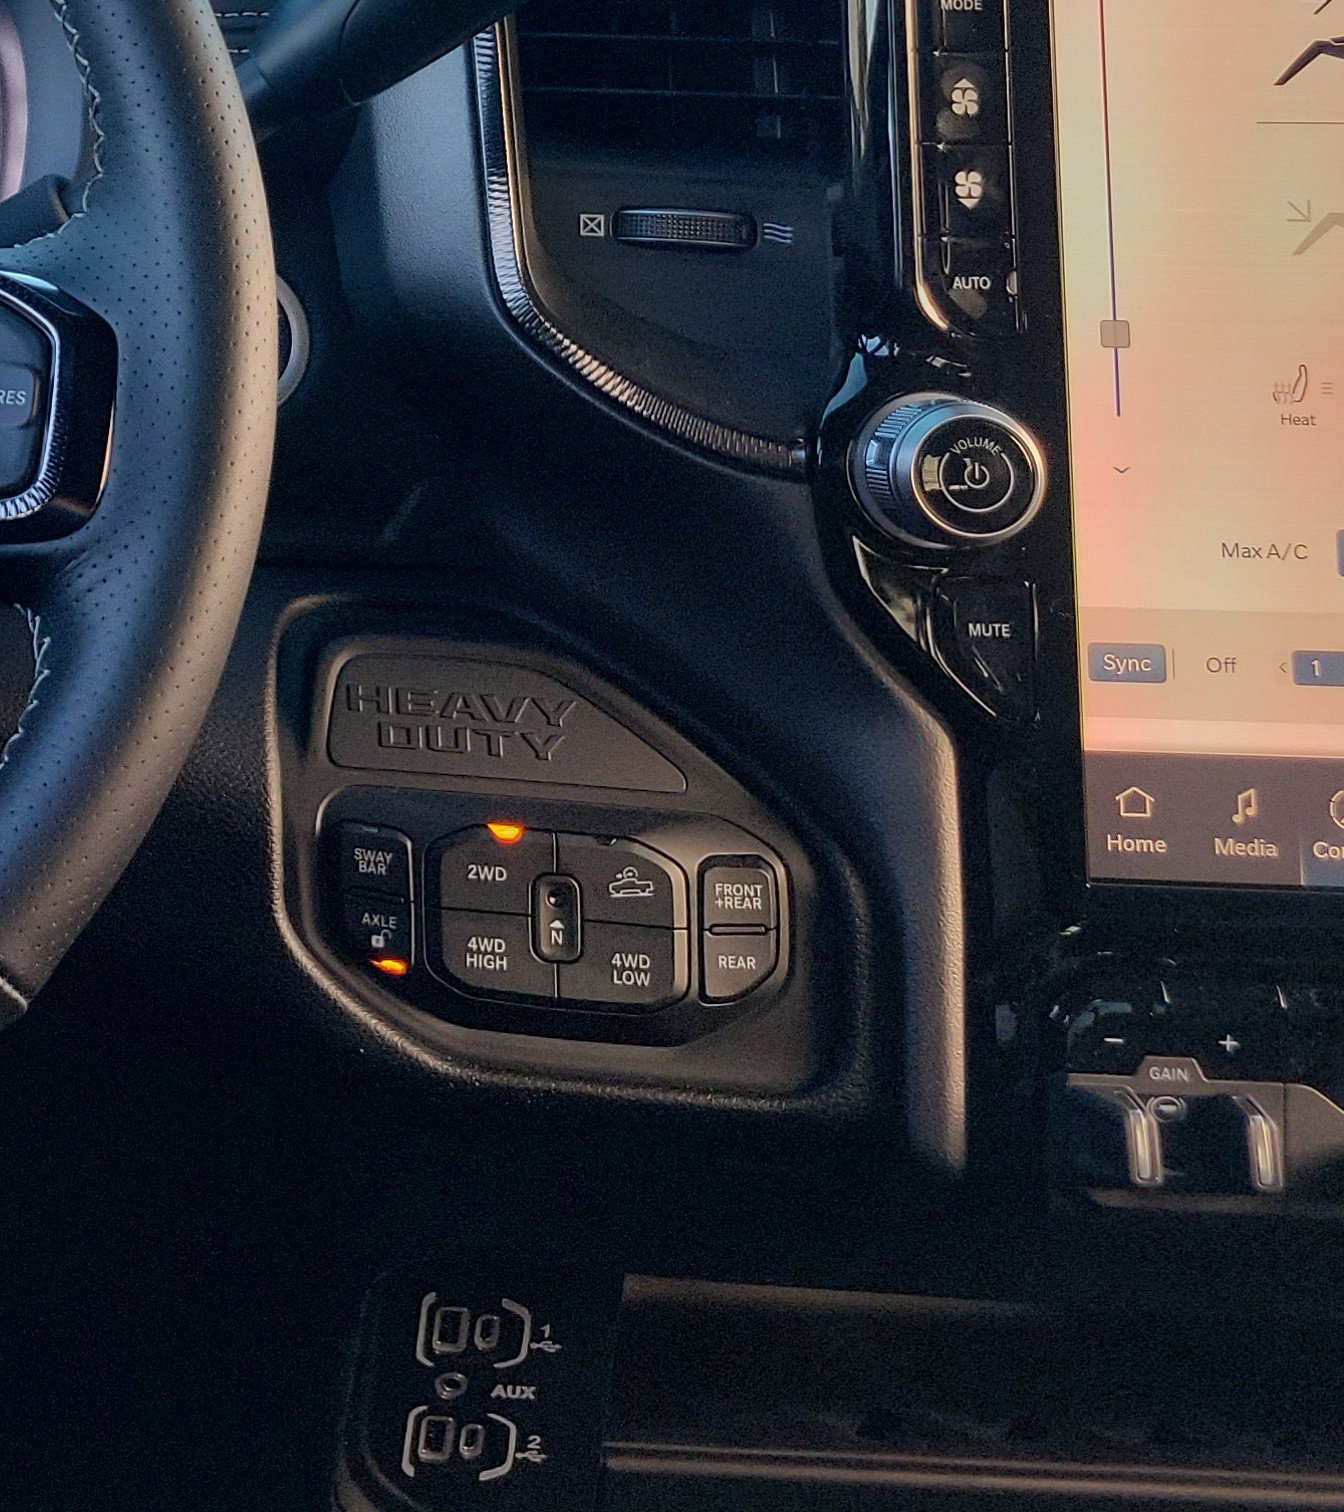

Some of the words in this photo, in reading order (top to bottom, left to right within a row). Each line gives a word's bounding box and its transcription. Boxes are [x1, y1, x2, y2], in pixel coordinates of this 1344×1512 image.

[952, 276, 991, 290] AUTO
[1280, 413, 1317, 427] Heat
[950, 437, 1002, 456] VOLUME
[1221, 543, 1263, 561] Max
[1266, 543, 1309, 561] A/C
[968, 623, 1011, 638] MUTE
[1102, 654, 1152, 673] Sync
[1206, 657, 1237, 674] Off
[343, 683, 580, 728] HEAVY
[377, 722, 567, 761] DUTY
[1106, 834, 1167, 854] Home
[1214, 837, 1279, 857] Media
[353, 848, 393, 865] SWAY
[358, 860, 387, 877] BAR
[467, 864, 508, 883] 2WD
[714, 882, 764, 899] FRONT
[361, 914, 397, 929] AXLE
[467, 936, 507, 954] 4WD
[550, 929, 564, 945] N
[465, 952, 508, 972] HIGH
[611, 952, 651, 970] 4WD
[717, 954, 757, 970] REAR
[612, 968, 651, 987] LOW
[1149, 1066, 1189, 1082] GAIN
[540, 1323, 551, 1338] 1
[490, 1384, 537, 1400] AUX
[527, 1435, 542, 1449] 2
